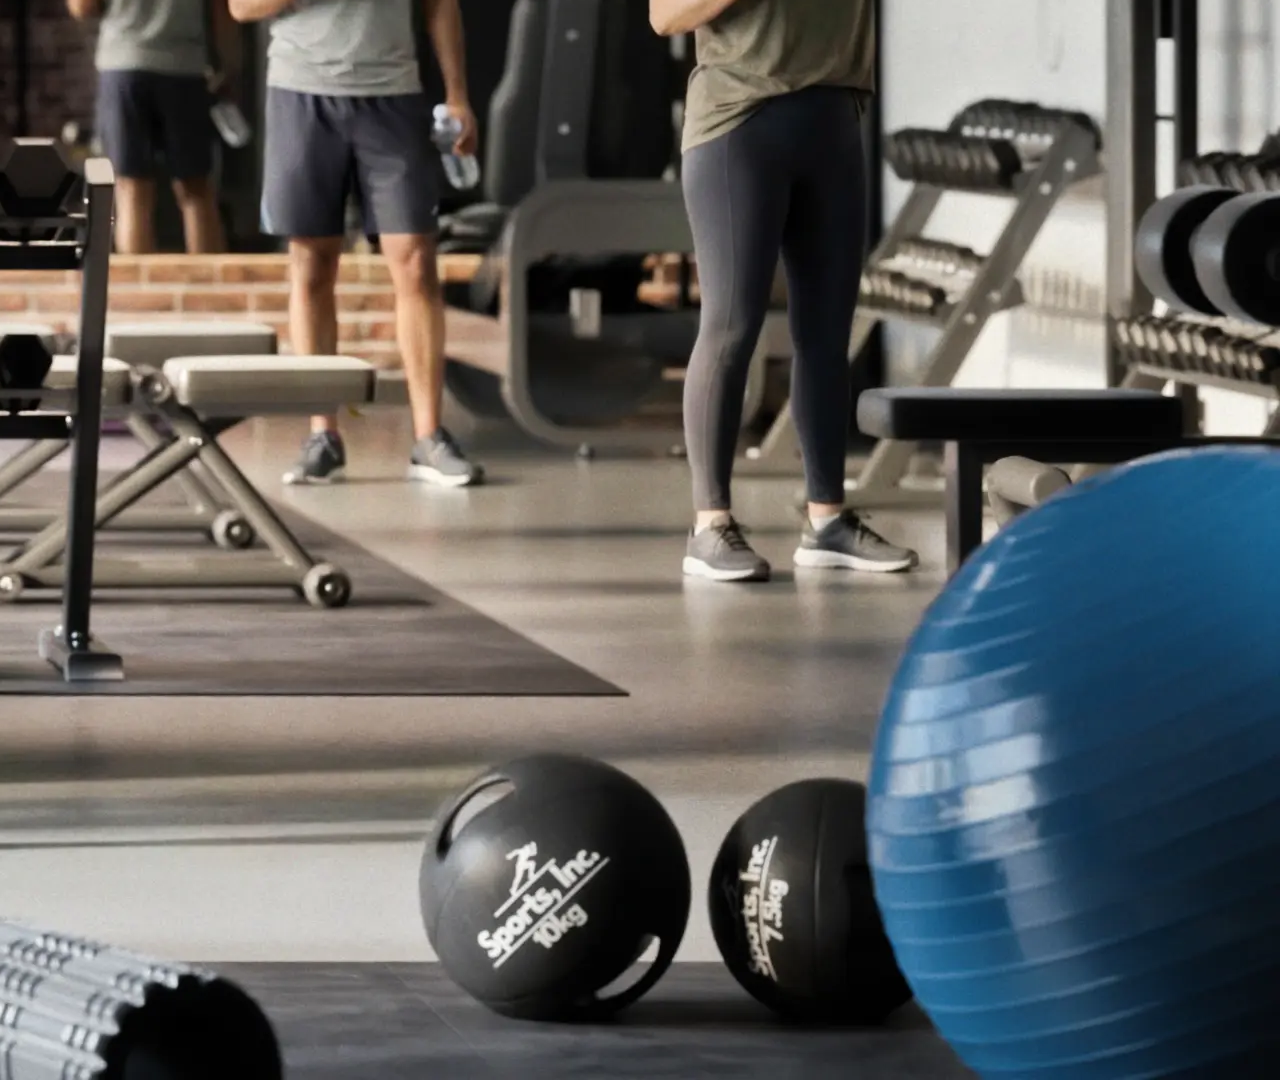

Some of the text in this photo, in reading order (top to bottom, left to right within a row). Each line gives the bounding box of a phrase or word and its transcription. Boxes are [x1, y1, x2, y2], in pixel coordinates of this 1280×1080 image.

[477, 849, 600, 959] Sports, Inc.
[532, 903, 589, 949] 10kg
[739, 838, 770, 977] Sports, Inc.
[760, 879, 790, 941] 7.5kg
